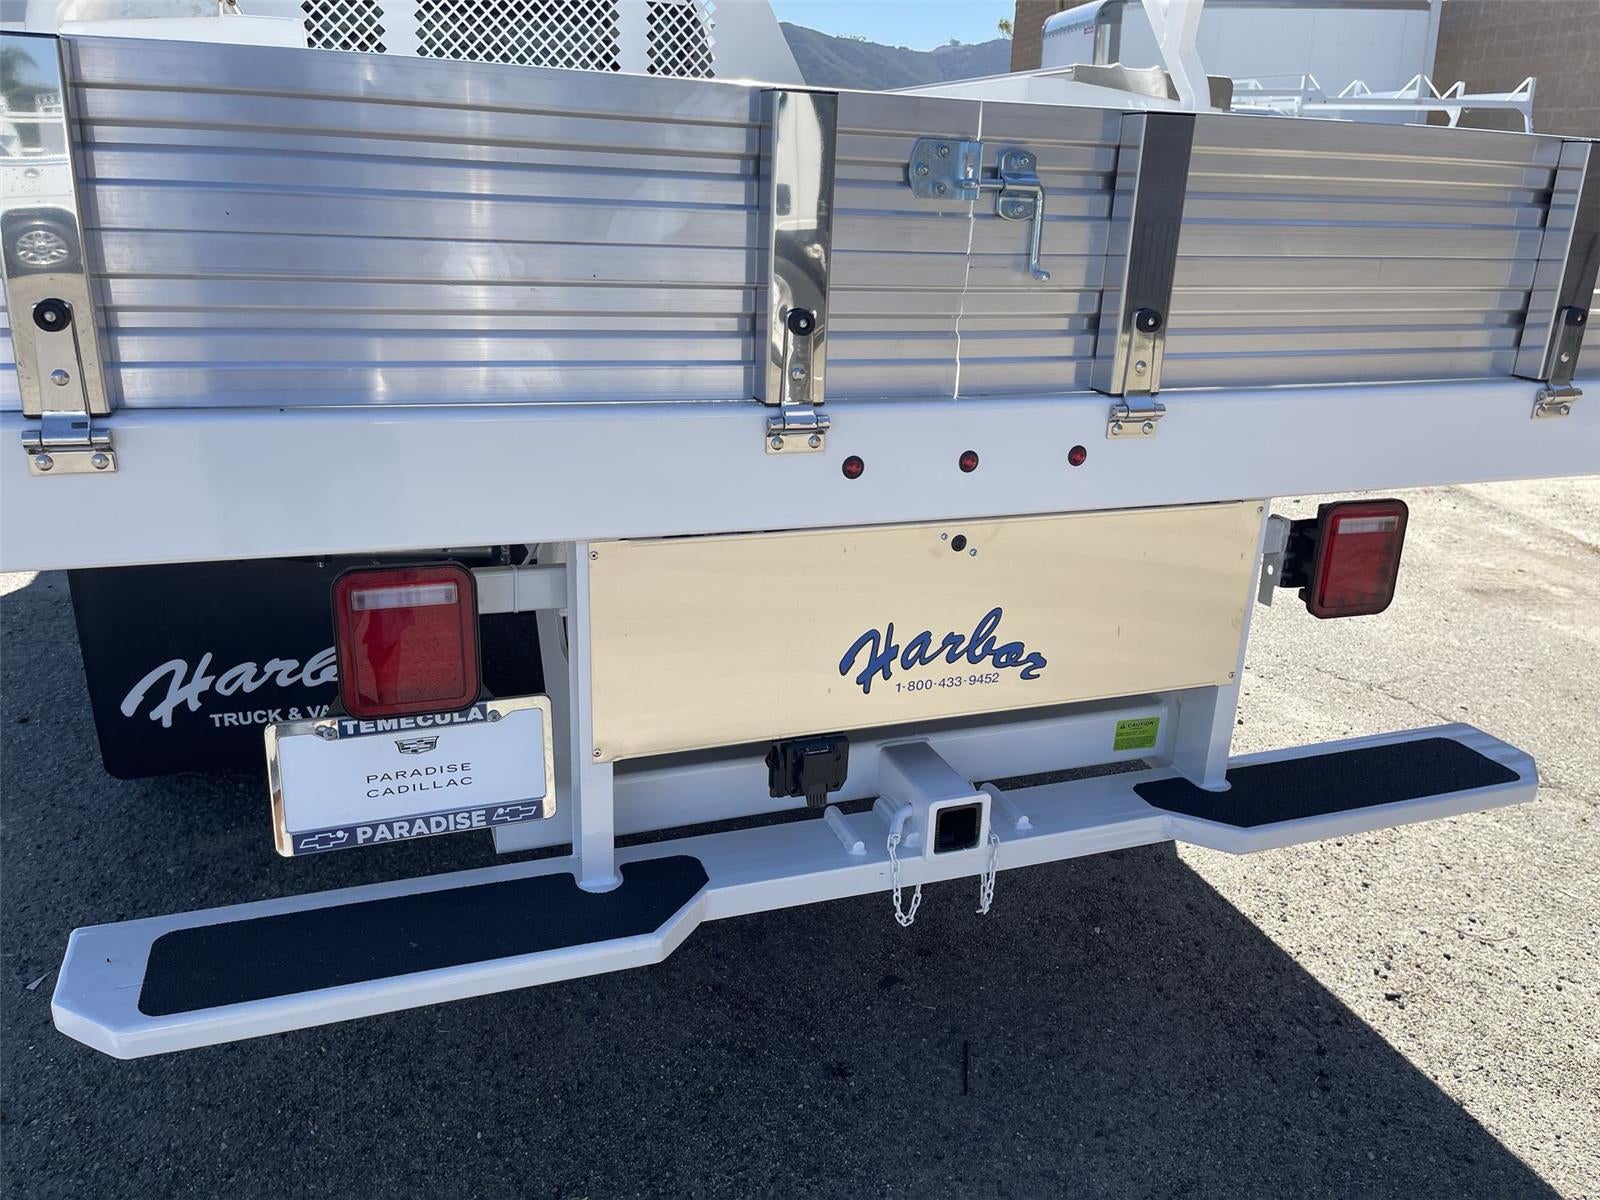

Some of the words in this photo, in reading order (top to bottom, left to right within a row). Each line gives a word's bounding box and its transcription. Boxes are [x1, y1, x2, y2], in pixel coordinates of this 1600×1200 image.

[838, 606, 1048, 695] Harbor
[119, 645, 339, 729] Harb
[209, 708, 285, 728] TRUCK
[288, 706, 303, 720] &
[306, 704, 330, 719] VA
[342, 706, 486, 735] TEMECULA
[1127, 720, 1154, 728] CAUTION
[366, 762, 473, 785] PARADISE
[366, 776, 474, 799] CADILLAC
[356, 809, 487, 845] PARADISE
